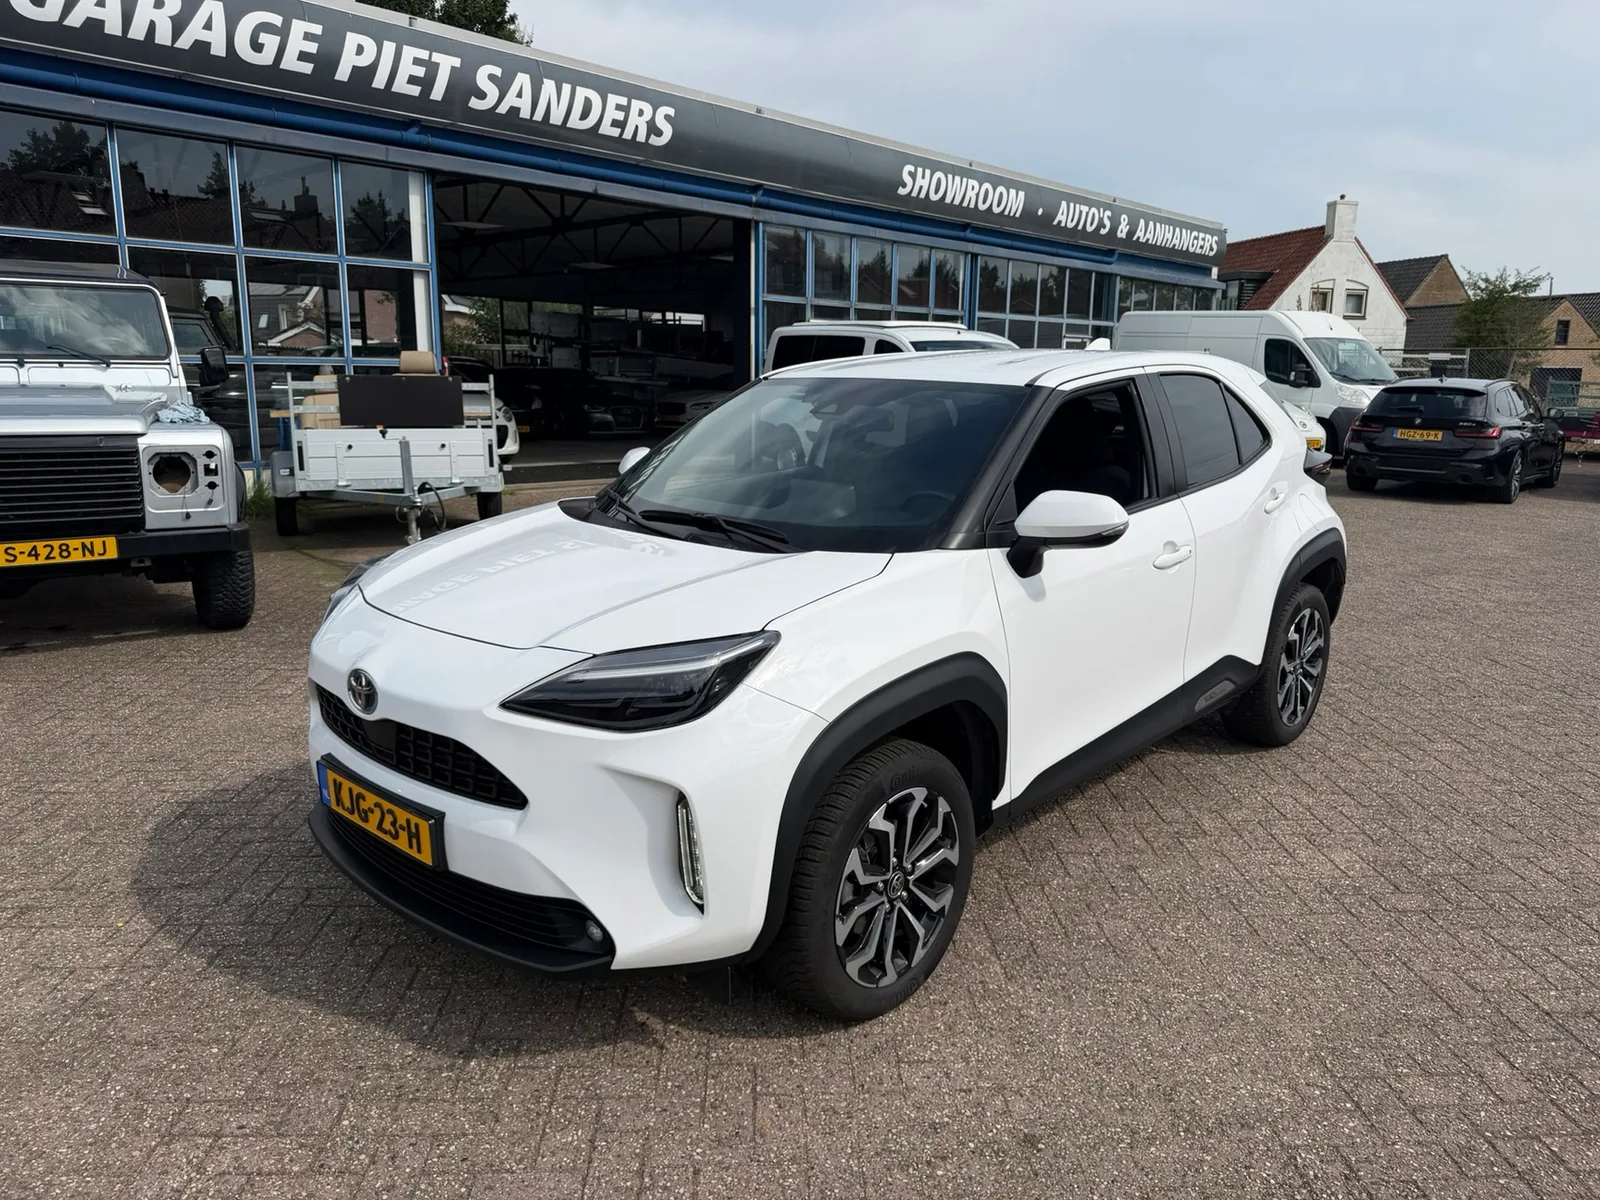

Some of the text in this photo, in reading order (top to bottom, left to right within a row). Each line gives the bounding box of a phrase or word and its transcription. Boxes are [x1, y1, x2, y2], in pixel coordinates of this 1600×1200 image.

[334, 31, 461, 101] PIET
[468, 64, 675, 146] SANDERS
[897, 165, 1218, 257] SHOWROOM AUTO'S & AANHANGERS
[1400, 430, 1440, 440] HGZ-69-K
[3, 540, 107, 563] S-428-NJ
[332, 777, 422, 855] KJG-23-H
